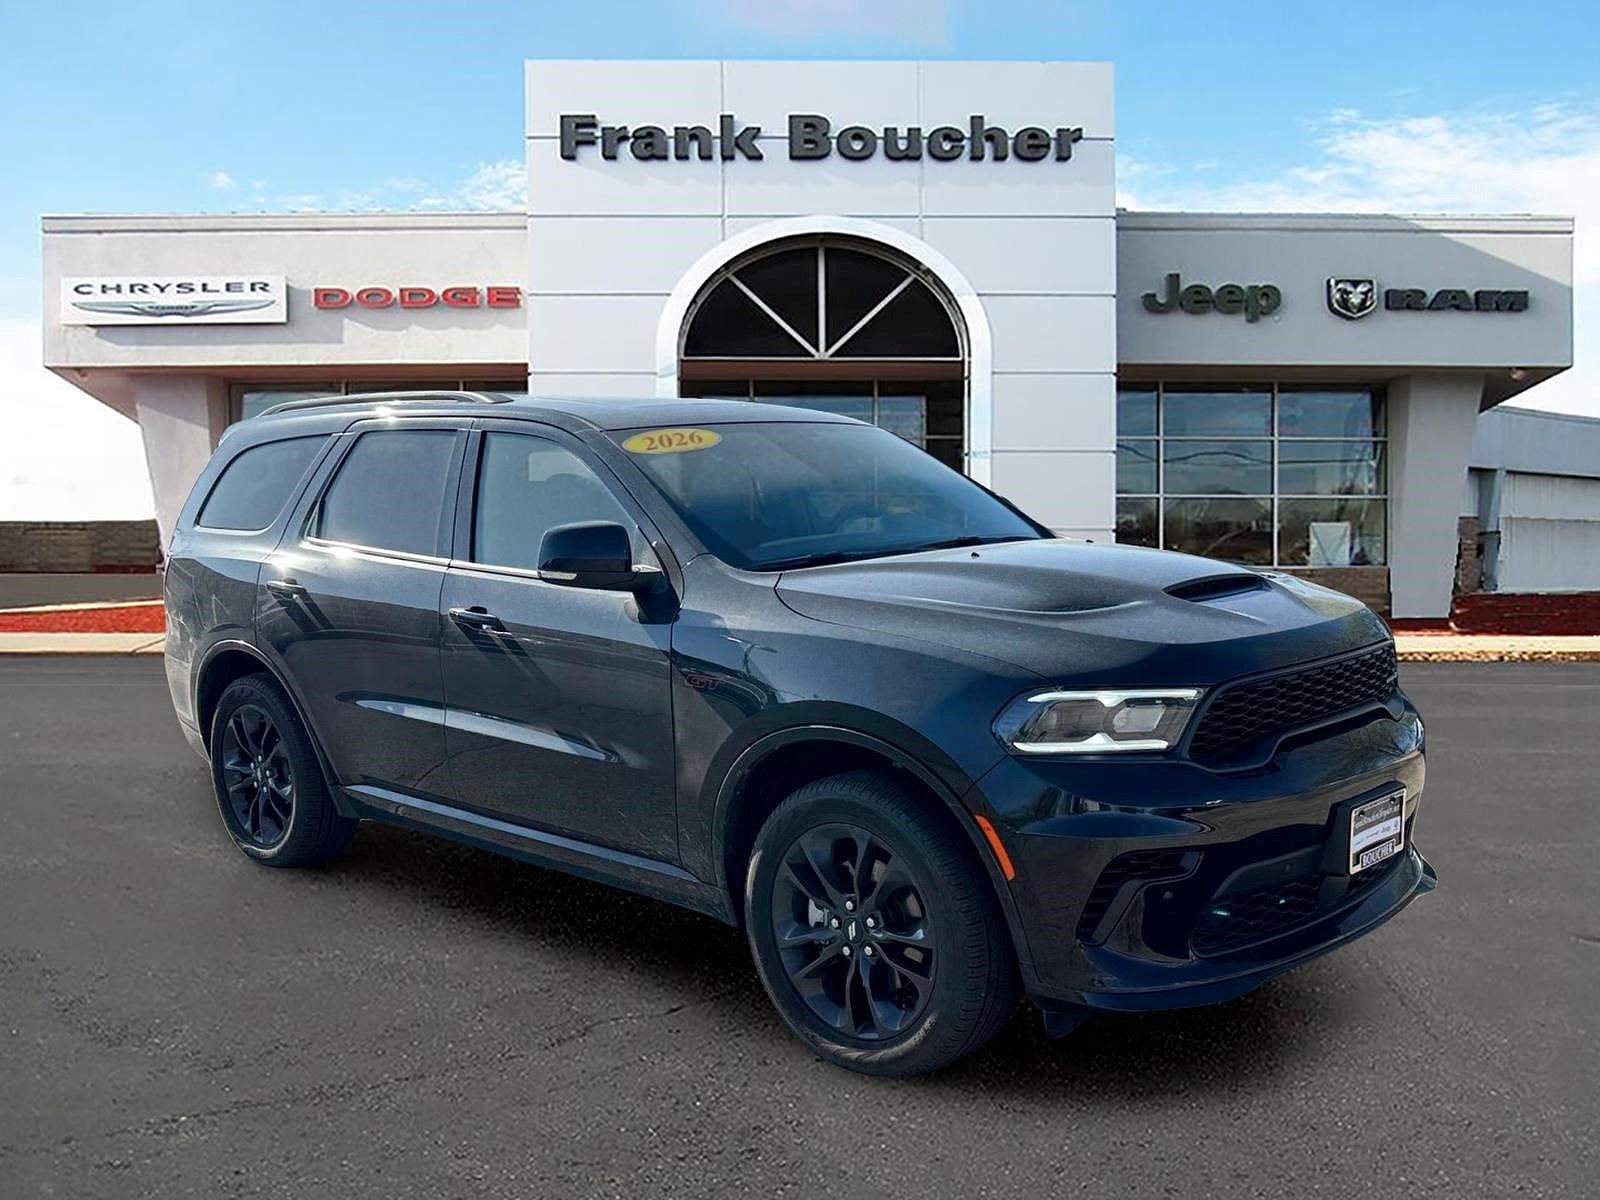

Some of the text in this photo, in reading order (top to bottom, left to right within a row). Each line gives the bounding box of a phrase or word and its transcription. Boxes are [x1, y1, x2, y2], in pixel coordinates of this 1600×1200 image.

[559, 114, 1082, 161] Frank Boucher
[73, 281, 270, 295] CHRYSLER
[313, 286, 522, 309] DODGE
[1141, 273, 1282, 323] Jeep
[1384, 288, 1529, 312] RAM
[643, 432, 703, 450] 2026
